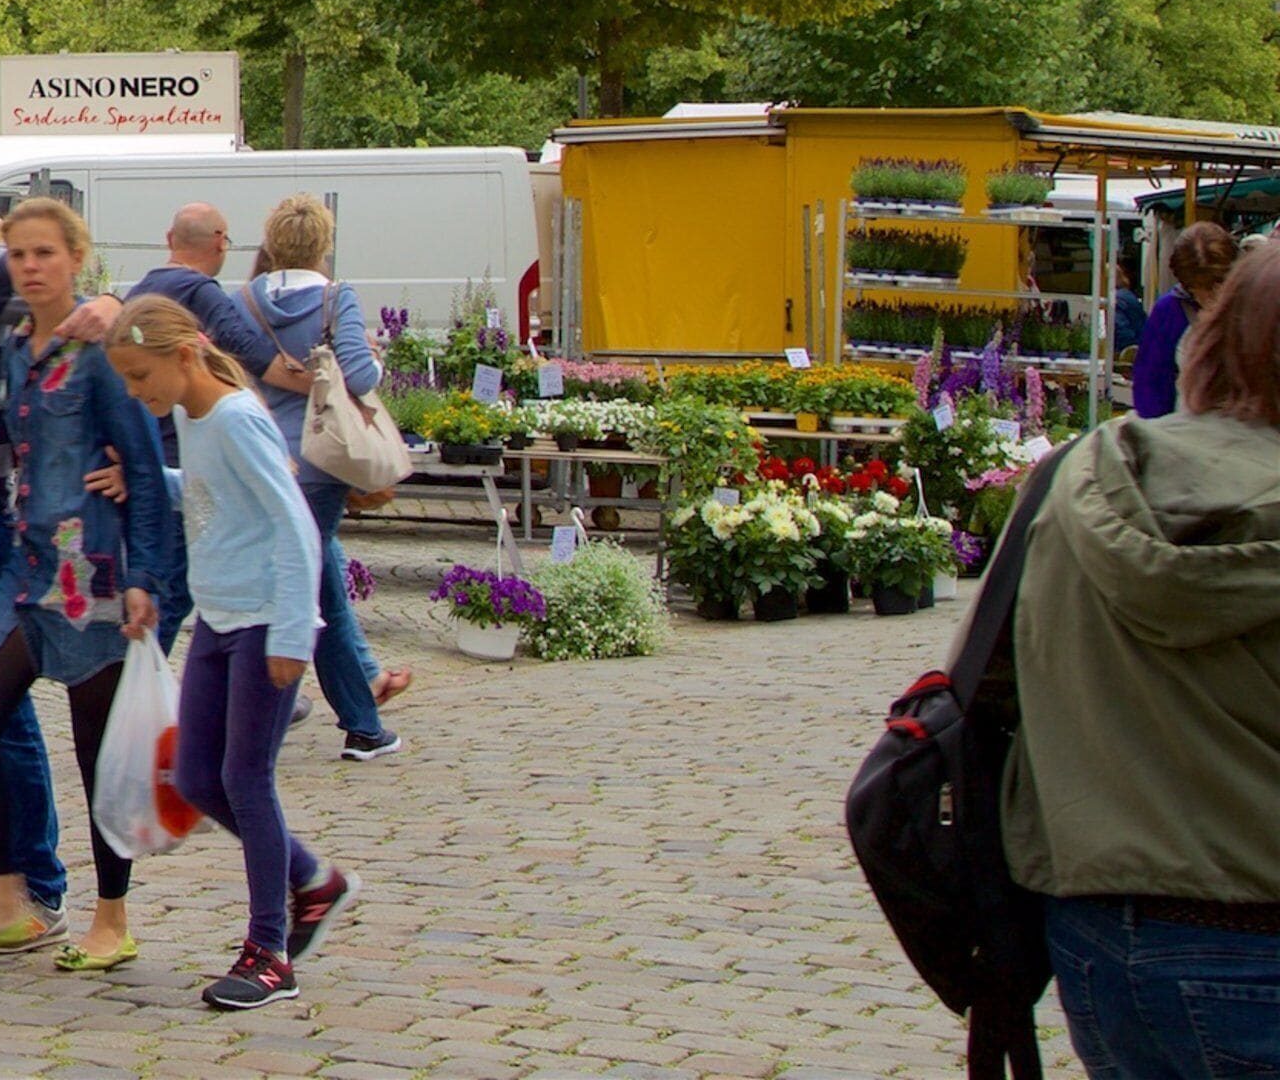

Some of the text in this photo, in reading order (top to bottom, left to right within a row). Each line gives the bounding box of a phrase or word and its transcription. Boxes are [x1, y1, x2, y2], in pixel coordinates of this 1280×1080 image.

[29, 76, 199, 98] ASINO NERO
[13, 106, 98, 128] Sardische
